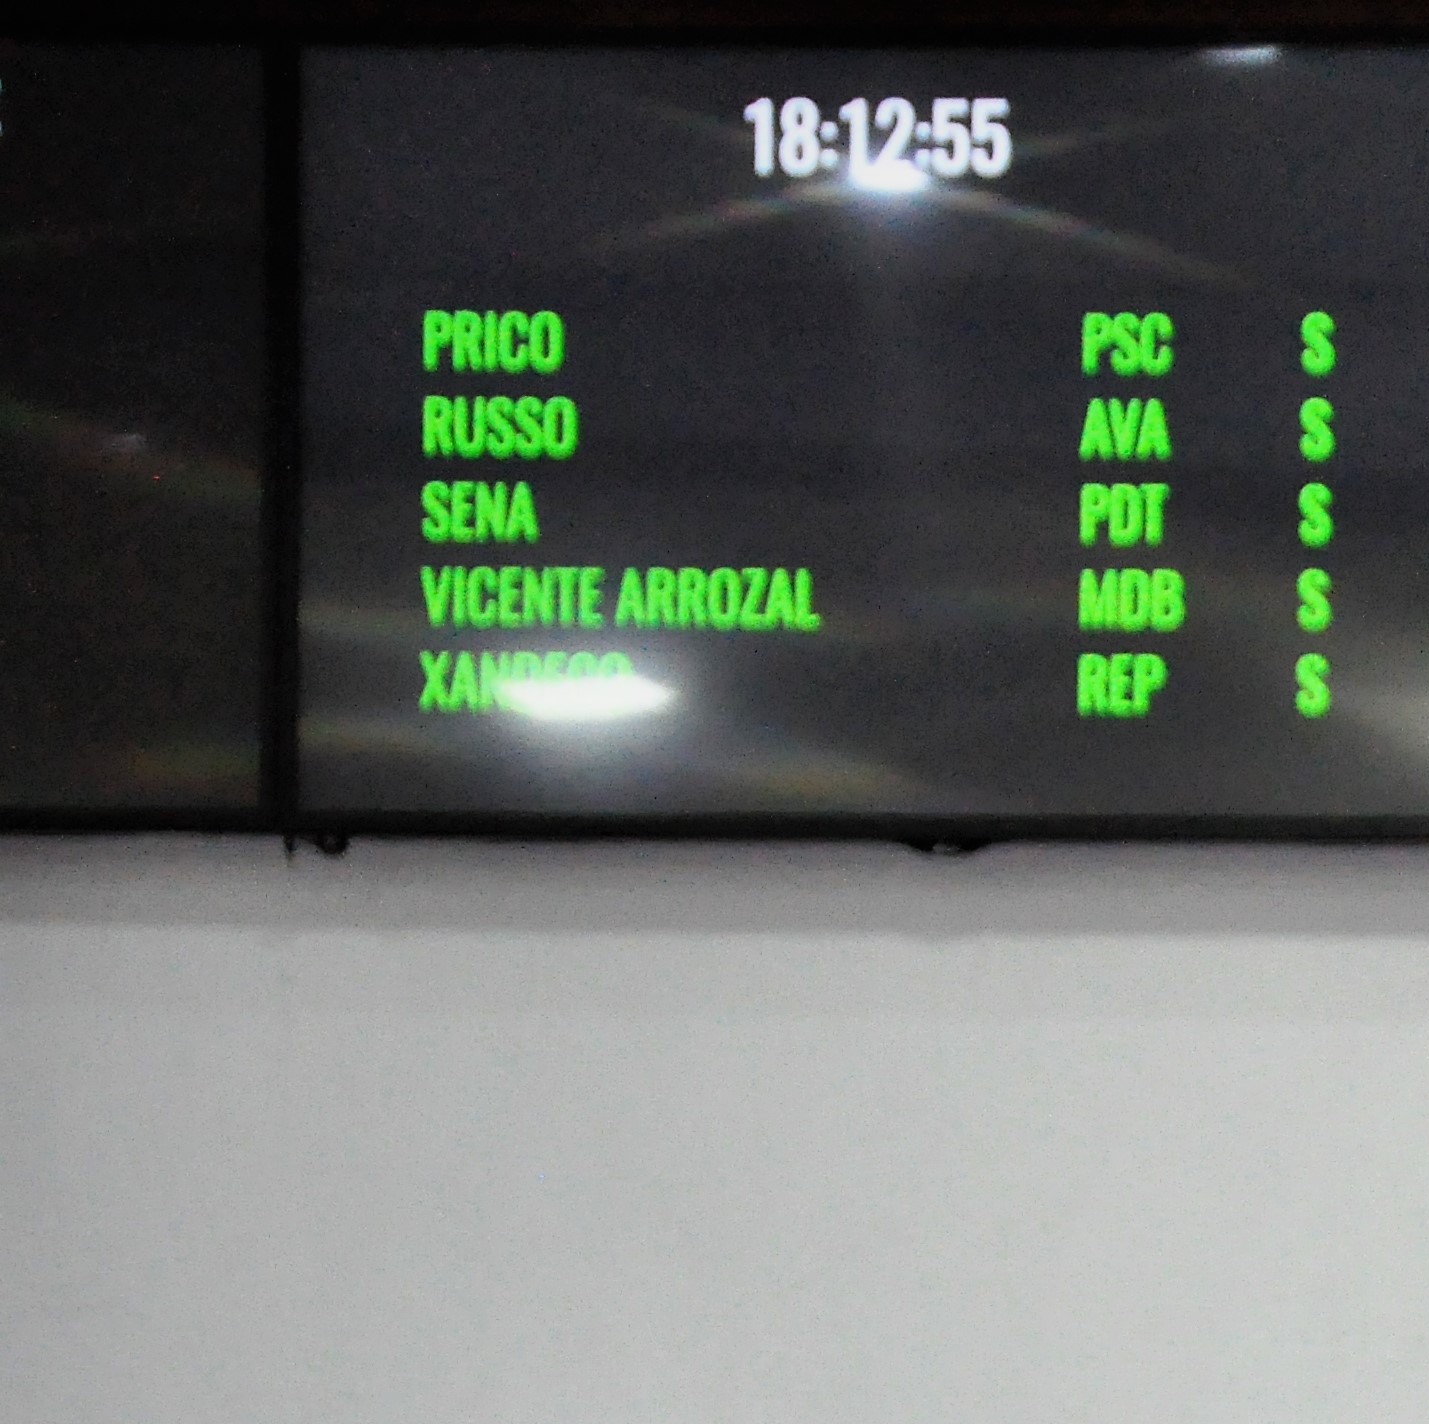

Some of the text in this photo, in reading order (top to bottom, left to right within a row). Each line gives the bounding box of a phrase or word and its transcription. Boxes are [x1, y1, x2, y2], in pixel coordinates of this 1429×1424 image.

[745, 98, 1011, 175] 18:12:55
[423, 310, 1337, 376] PRICO PSC S
[422, 395, 1336, 462] RUSSO AVA S
[421, 480, 1334, 548] SENA PDT S
[421, 566, 1332, 632] VICENTE ARROZAL MDB S
[1077, 653, 1168, 718] REP
[1296, 653, 1331, 717] S
